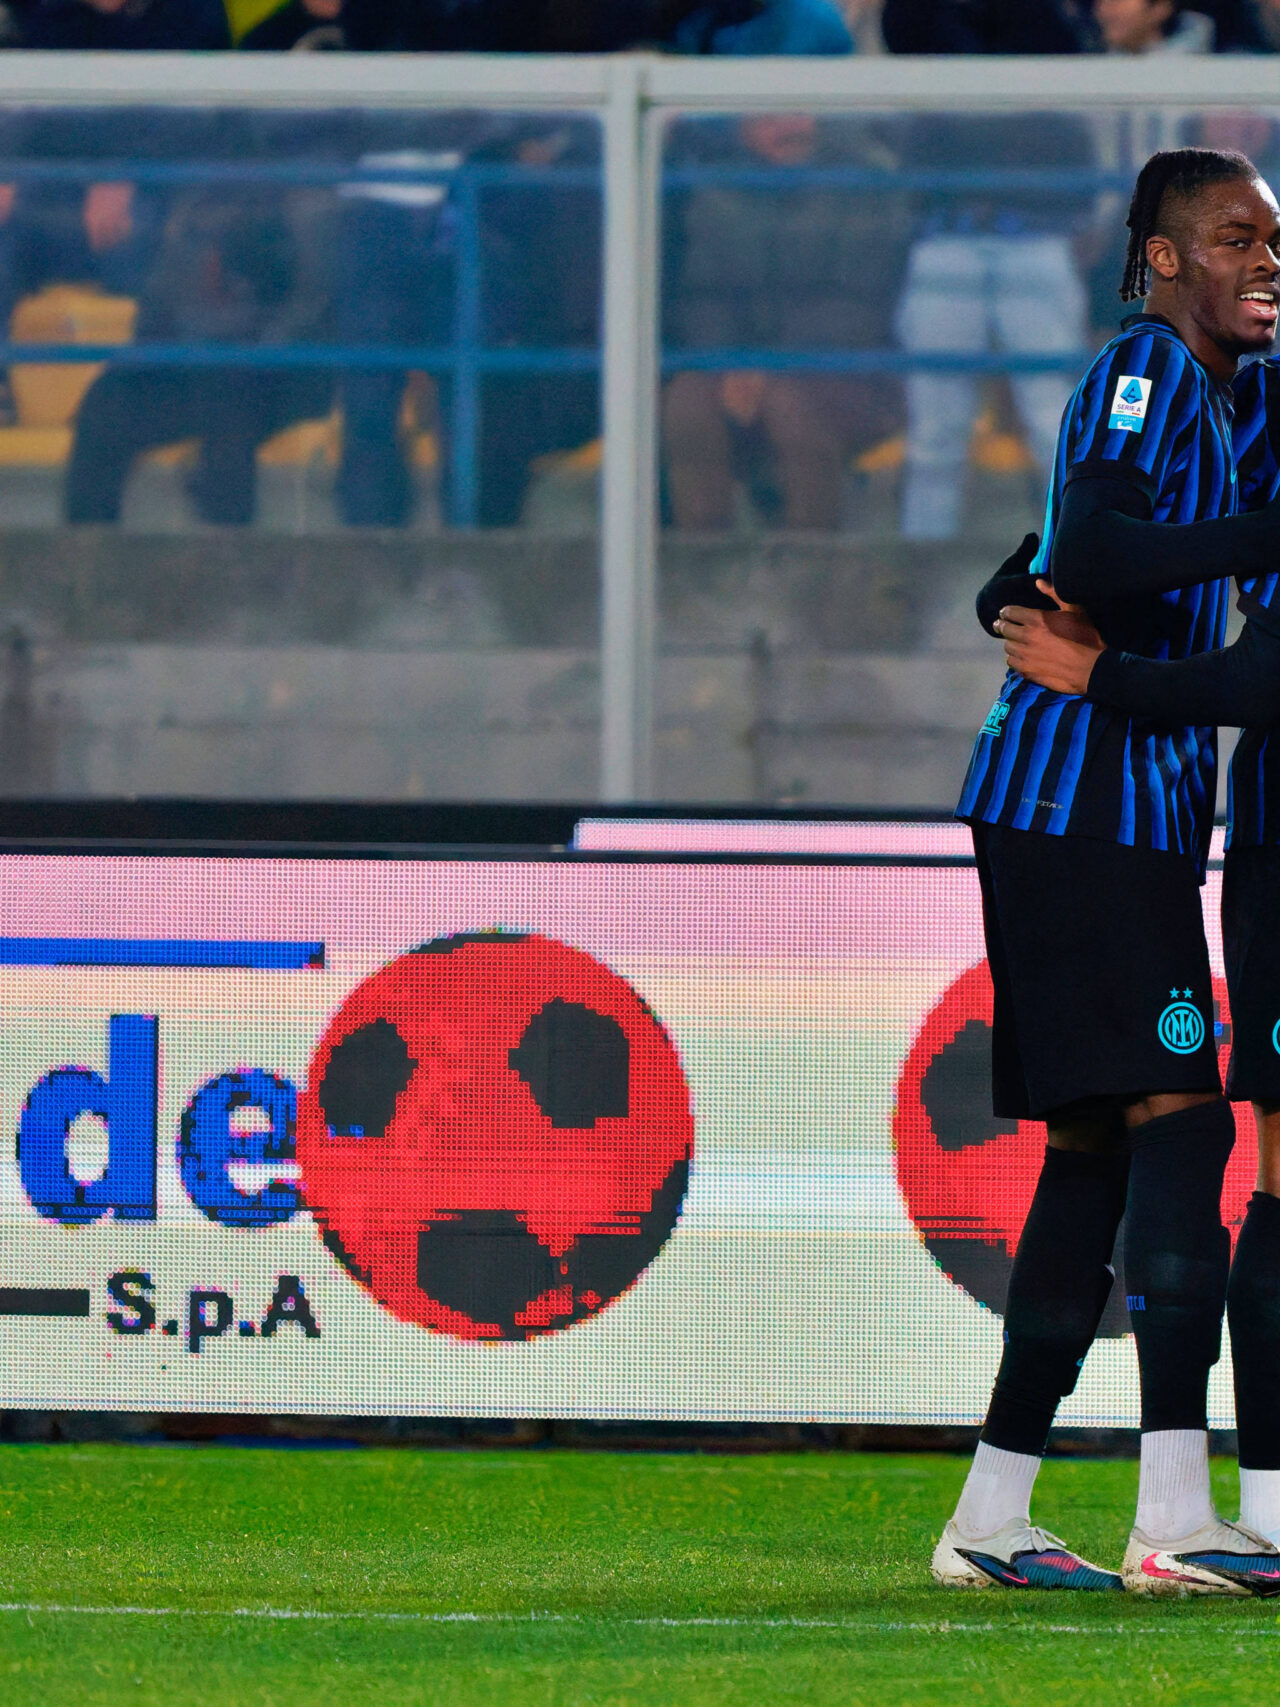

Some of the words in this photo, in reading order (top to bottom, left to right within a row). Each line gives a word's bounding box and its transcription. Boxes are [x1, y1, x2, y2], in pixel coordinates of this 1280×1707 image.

[1117, 403, 1135, 412] SERIE
[15, 1014, 304, 1228] de
[105, 1269, 322, 1353] S.p.A
